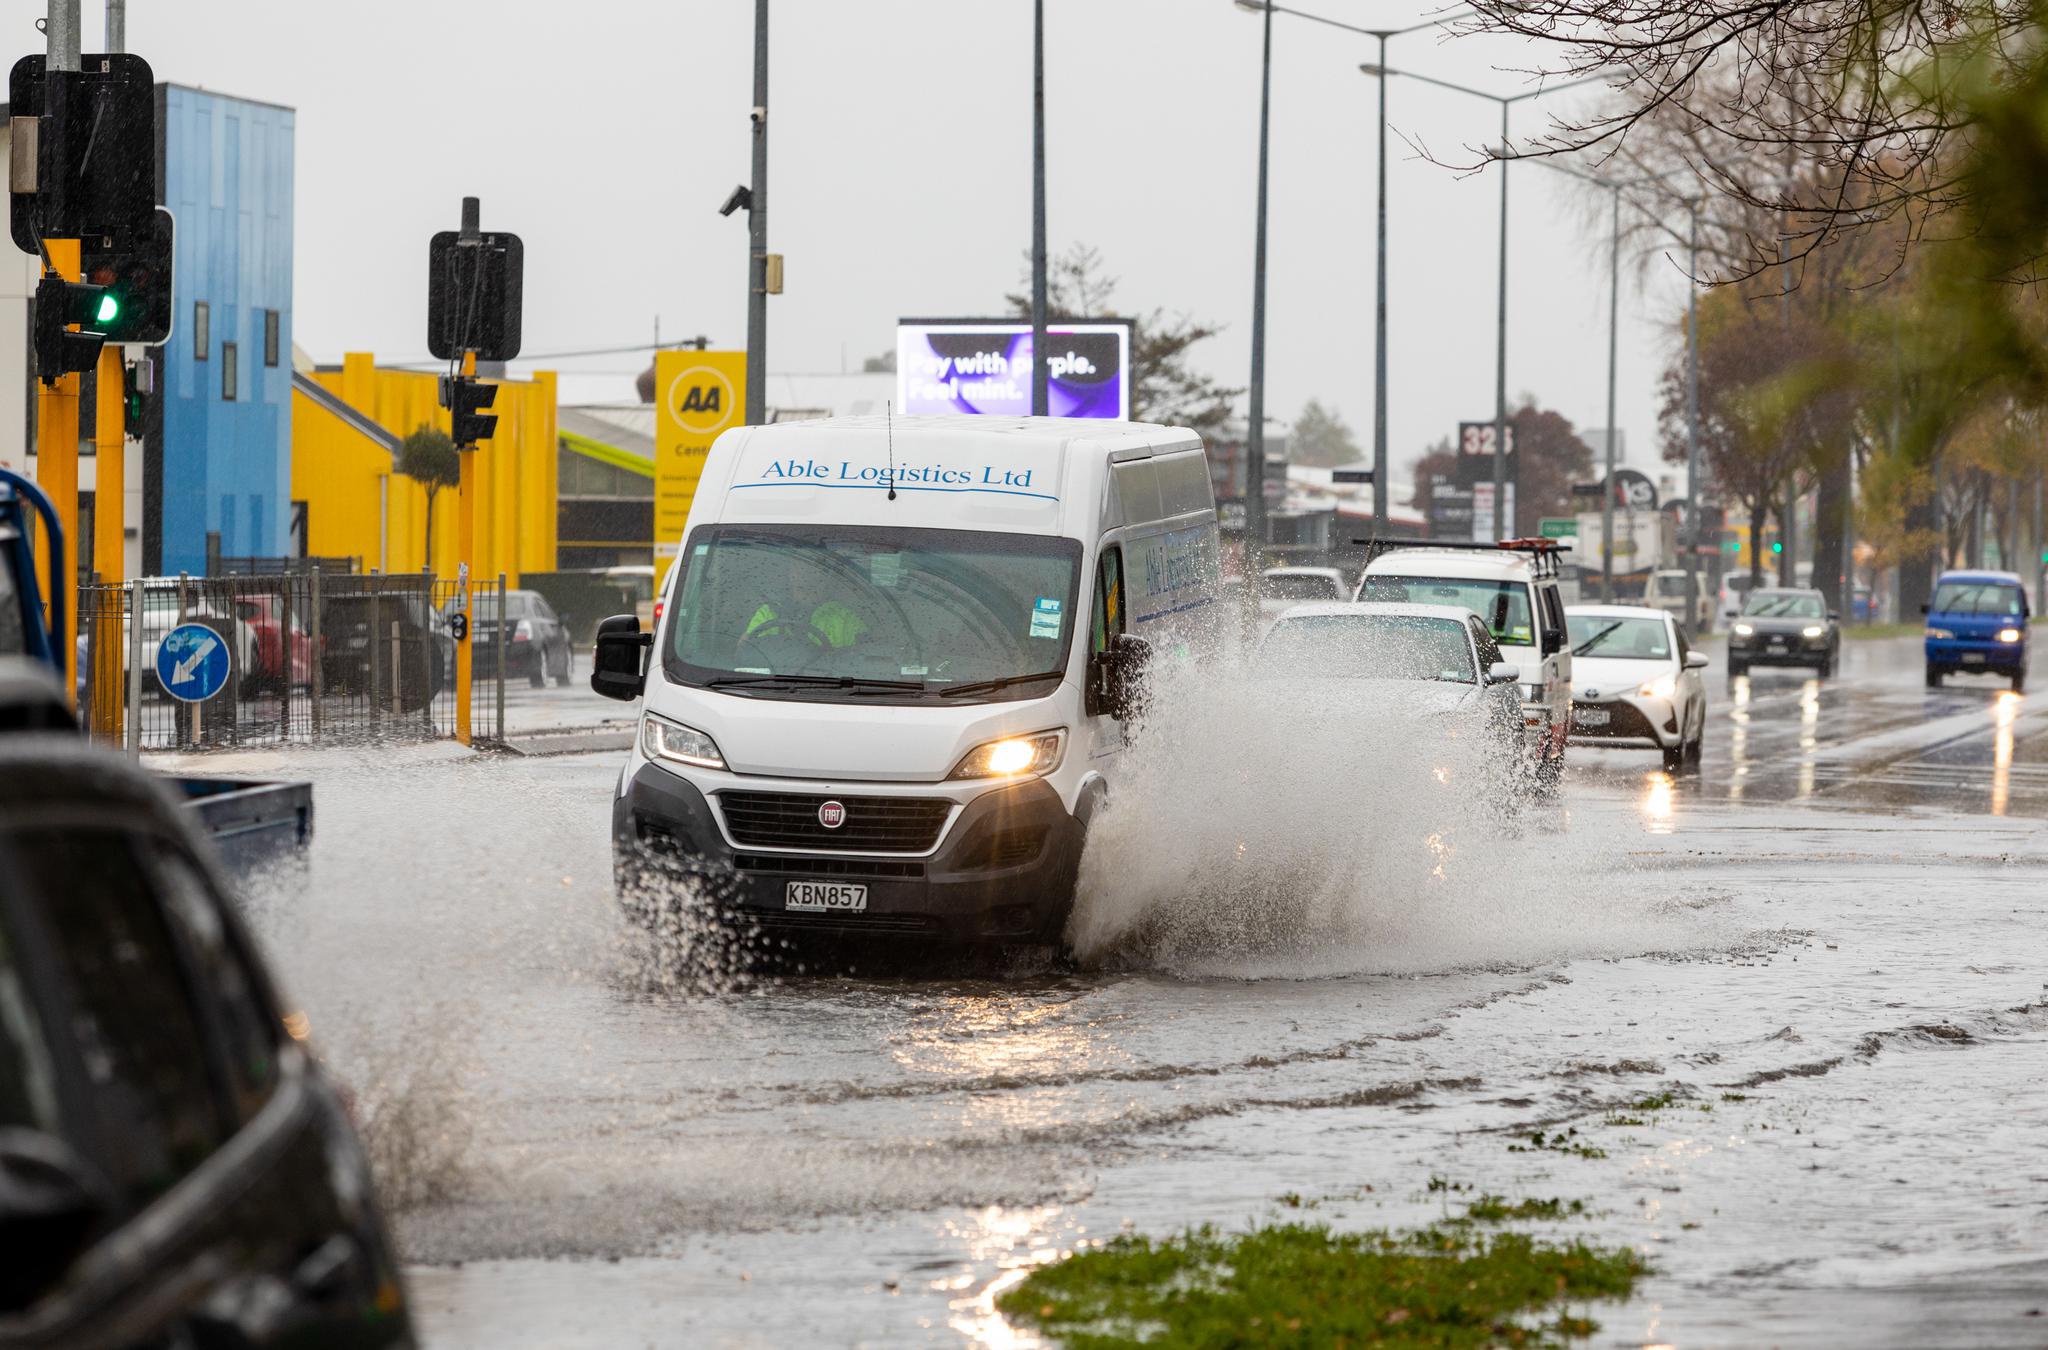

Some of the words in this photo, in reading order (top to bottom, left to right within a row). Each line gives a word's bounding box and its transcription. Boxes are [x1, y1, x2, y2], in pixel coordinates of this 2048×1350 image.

[908, 352, 950, 378] Pay
[955, 351, 1008, 374] with
[1012, 351, 1097, 379] pple.
[681, 386, 721, 413] AA
[908, 377, 958, 401] Feel
[962, 378, 1024, 401] mint.
[761, 460, 829, 479] Able
[840, 462, 971, 486] Logistics
[980, 466, 1033, 487] Ltd
[824, 809, 841, 821] FIAT
[788, 884, 866, 907] KBN857
